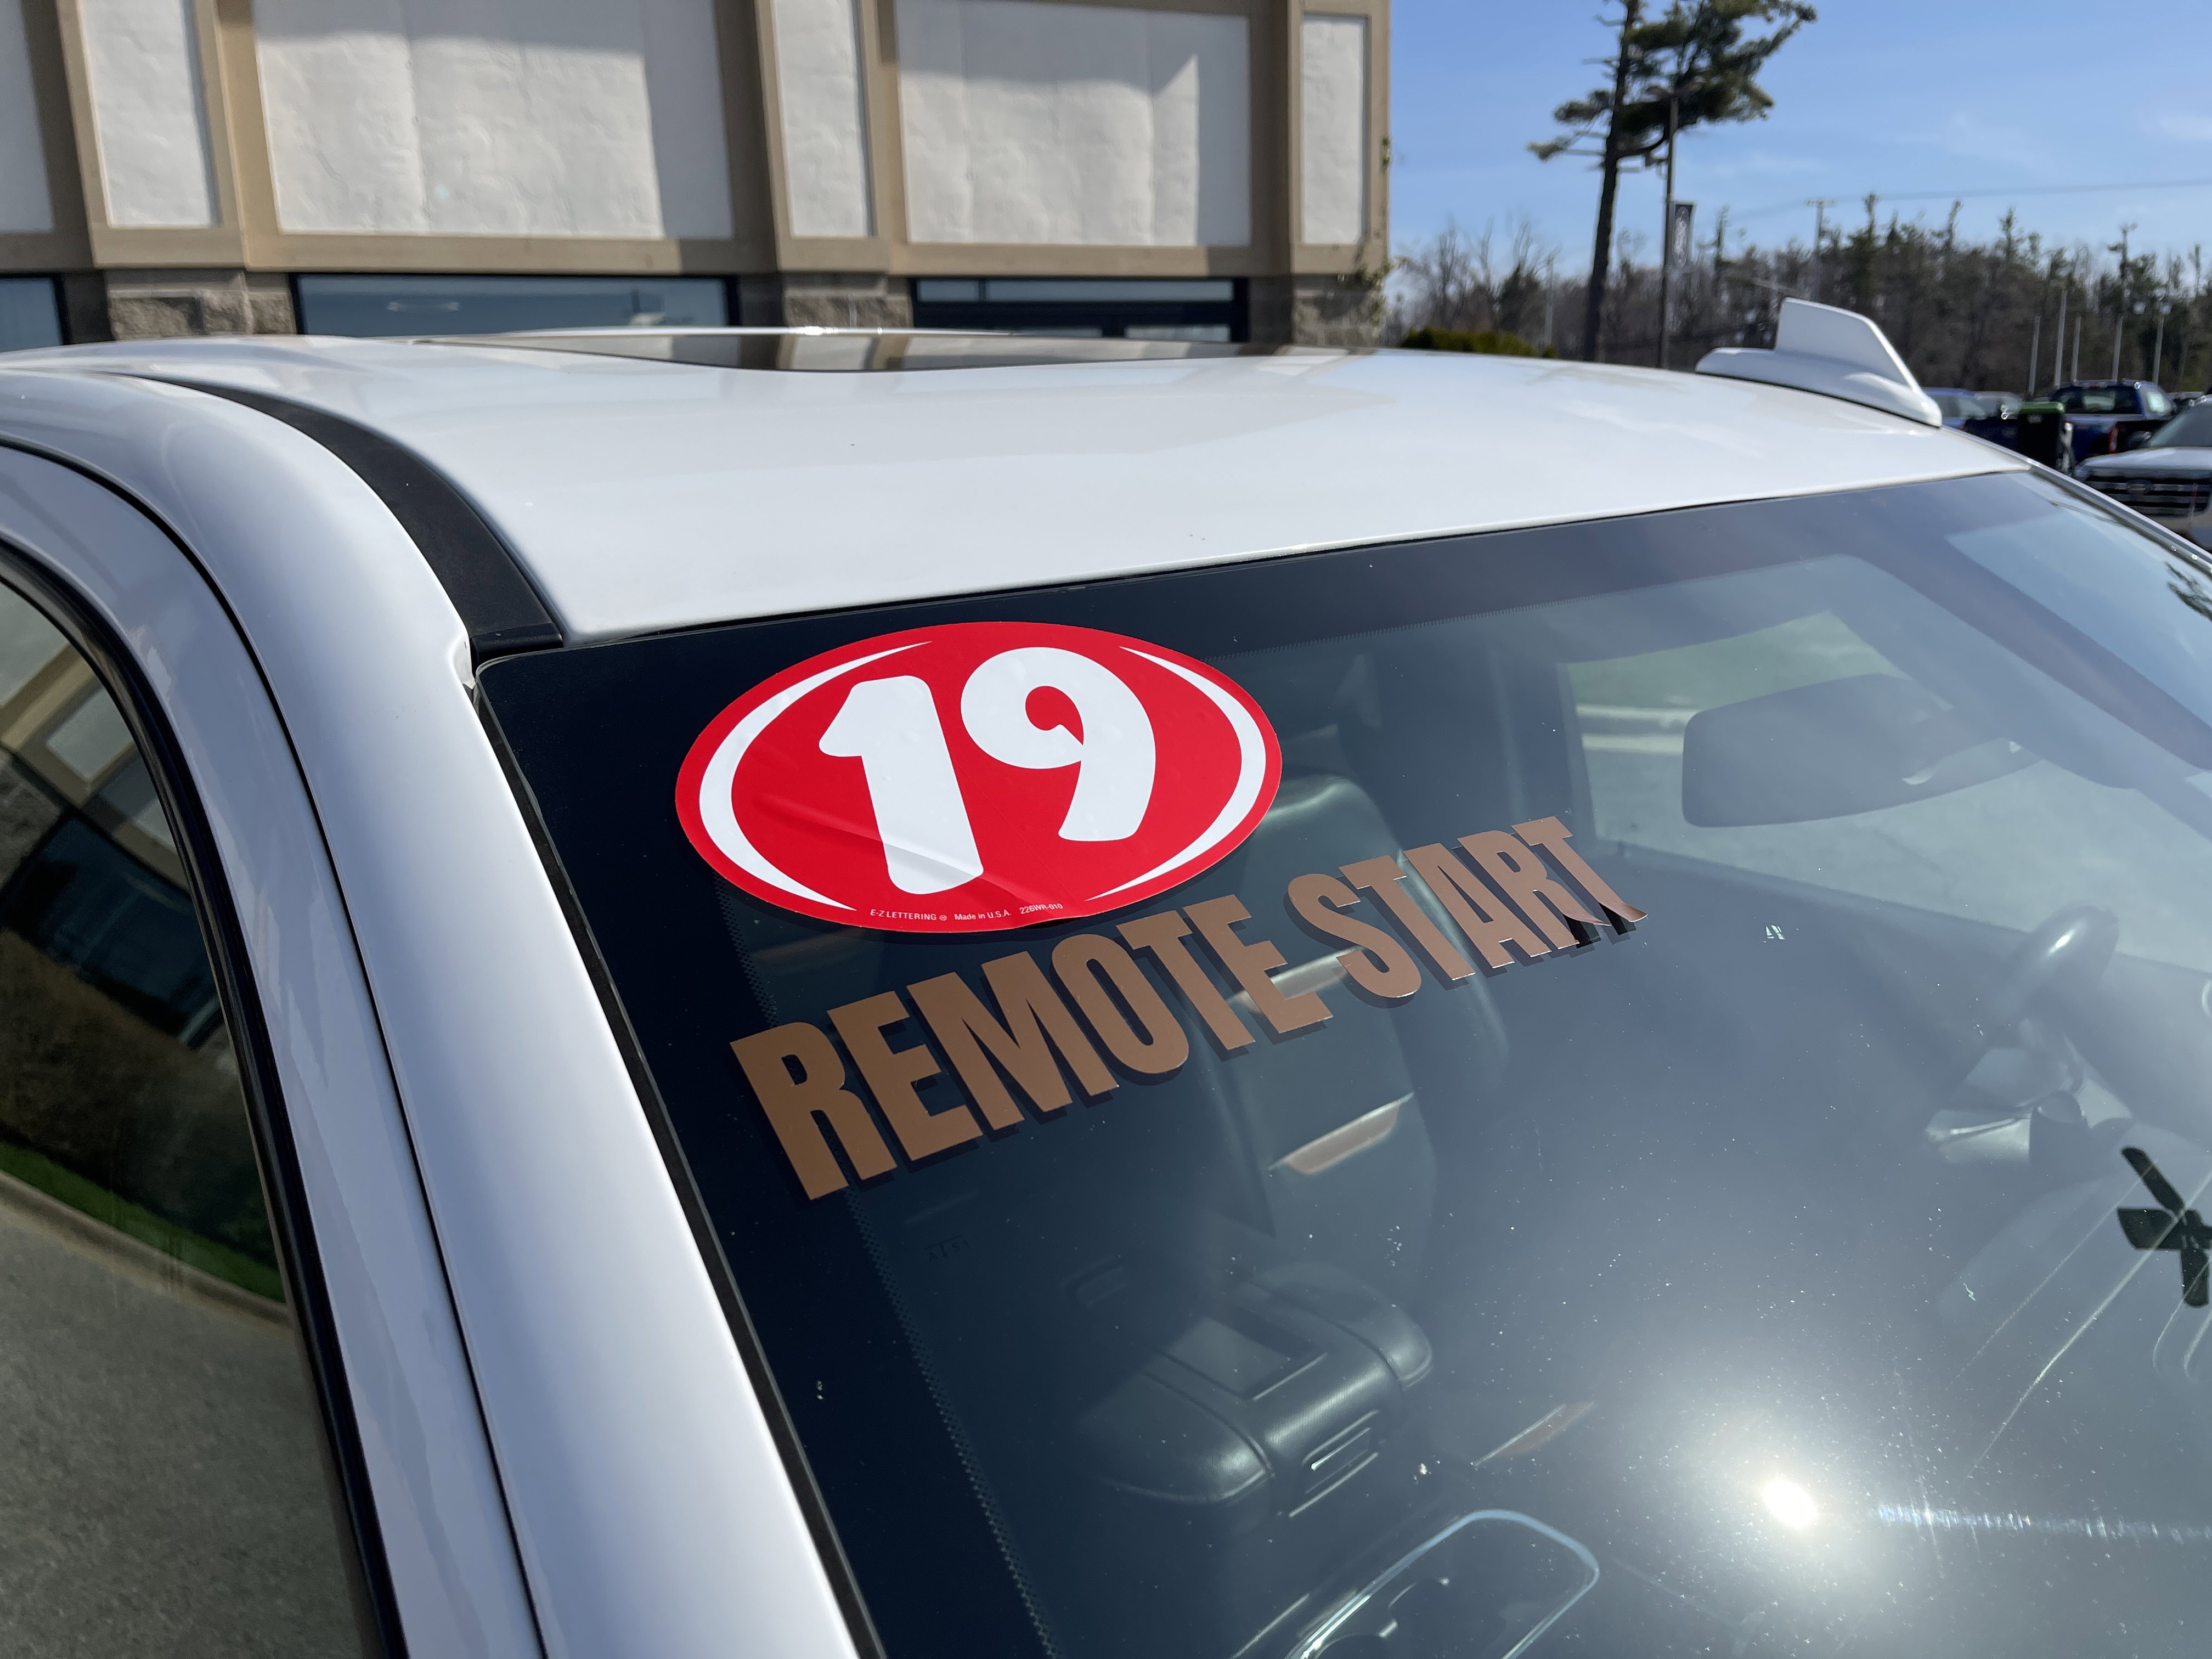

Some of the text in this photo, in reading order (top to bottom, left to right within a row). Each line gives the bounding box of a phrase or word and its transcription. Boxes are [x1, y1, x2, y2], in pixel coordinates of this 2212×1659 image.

[819, 647, 1155, 895] 19
[731, 817, 1646, 1199] REMOTE START
[870, 909, 885, 917] E-Z
[886, 911, 937, 921] LETTERING
[1019, 903, 1064, 915] 226WR-010
